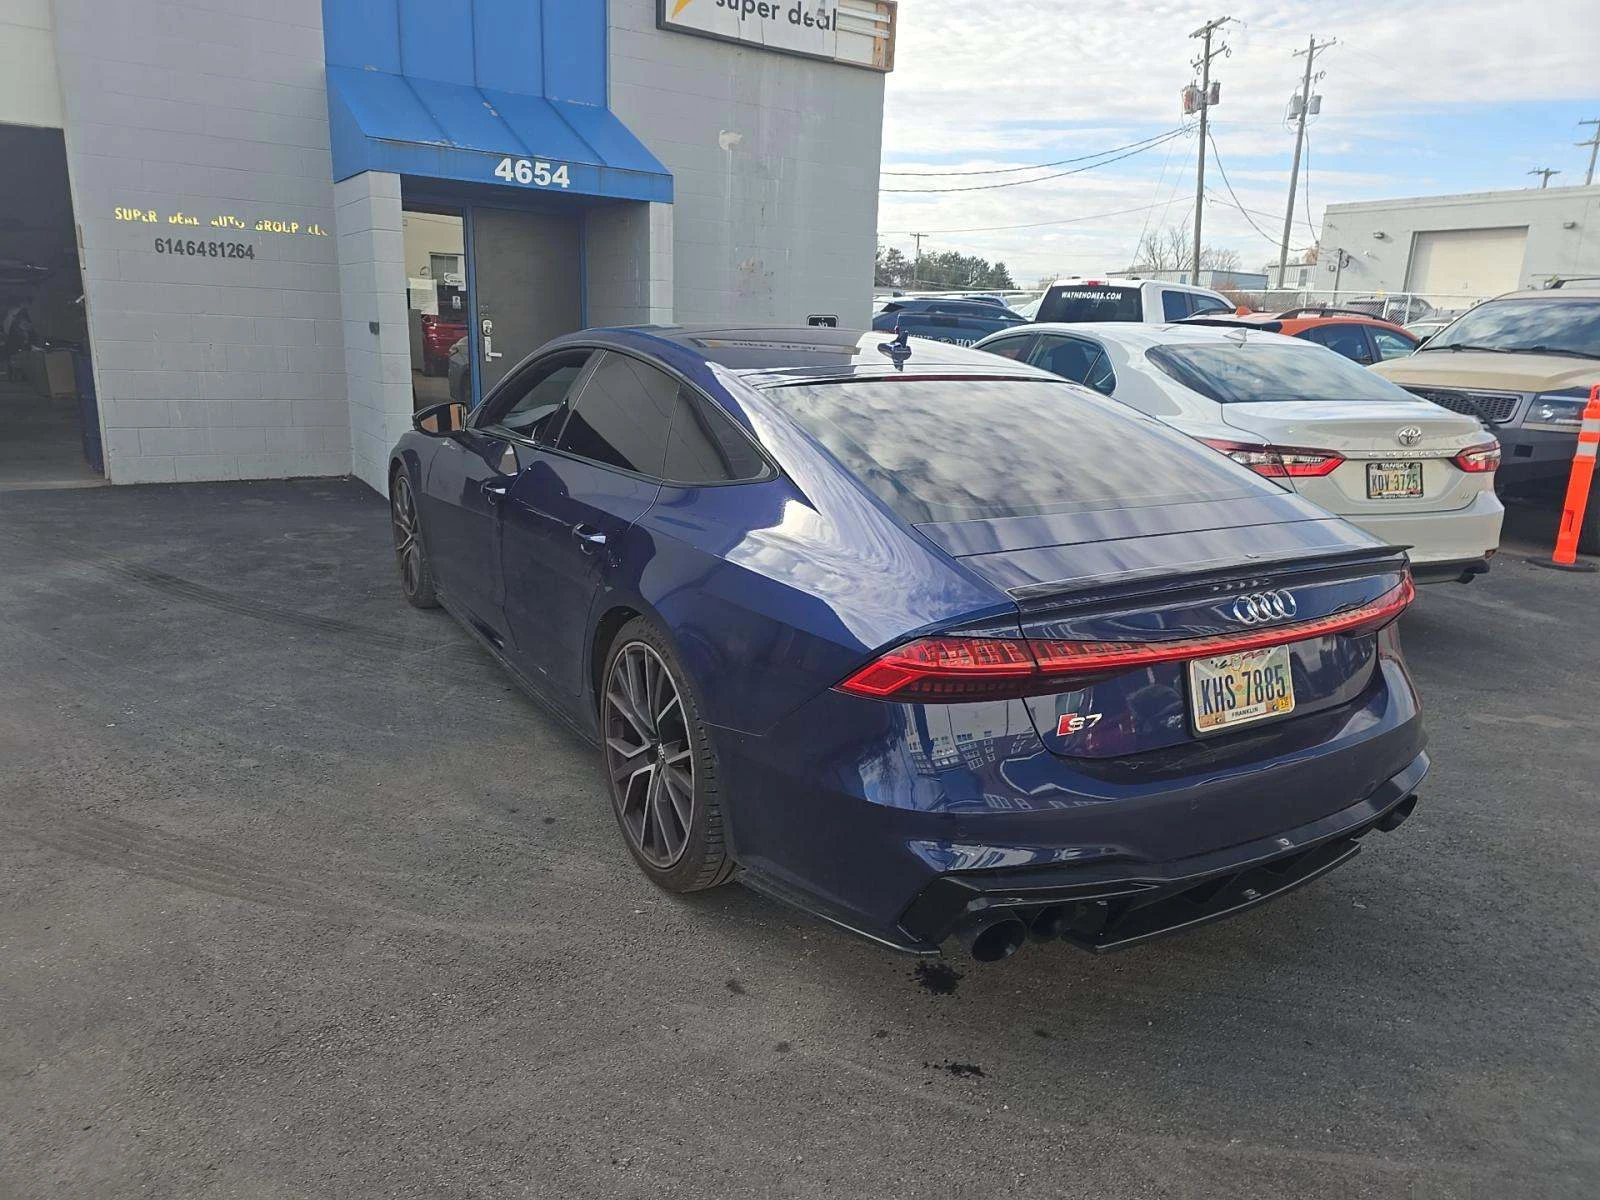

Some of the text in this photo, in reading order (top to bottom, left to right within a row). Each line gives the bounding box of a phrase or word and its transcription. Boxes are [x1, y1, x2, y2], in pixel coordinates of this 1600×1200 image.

[494, 158, 571, 188] 4654
[154, 238, 255, 260] 6146481264
[1200, 664, 1286, 716] KHS 7885
[1067, 713, 1102, 732] S7
[1231, 706, 1259, 718] FRANKLIN
